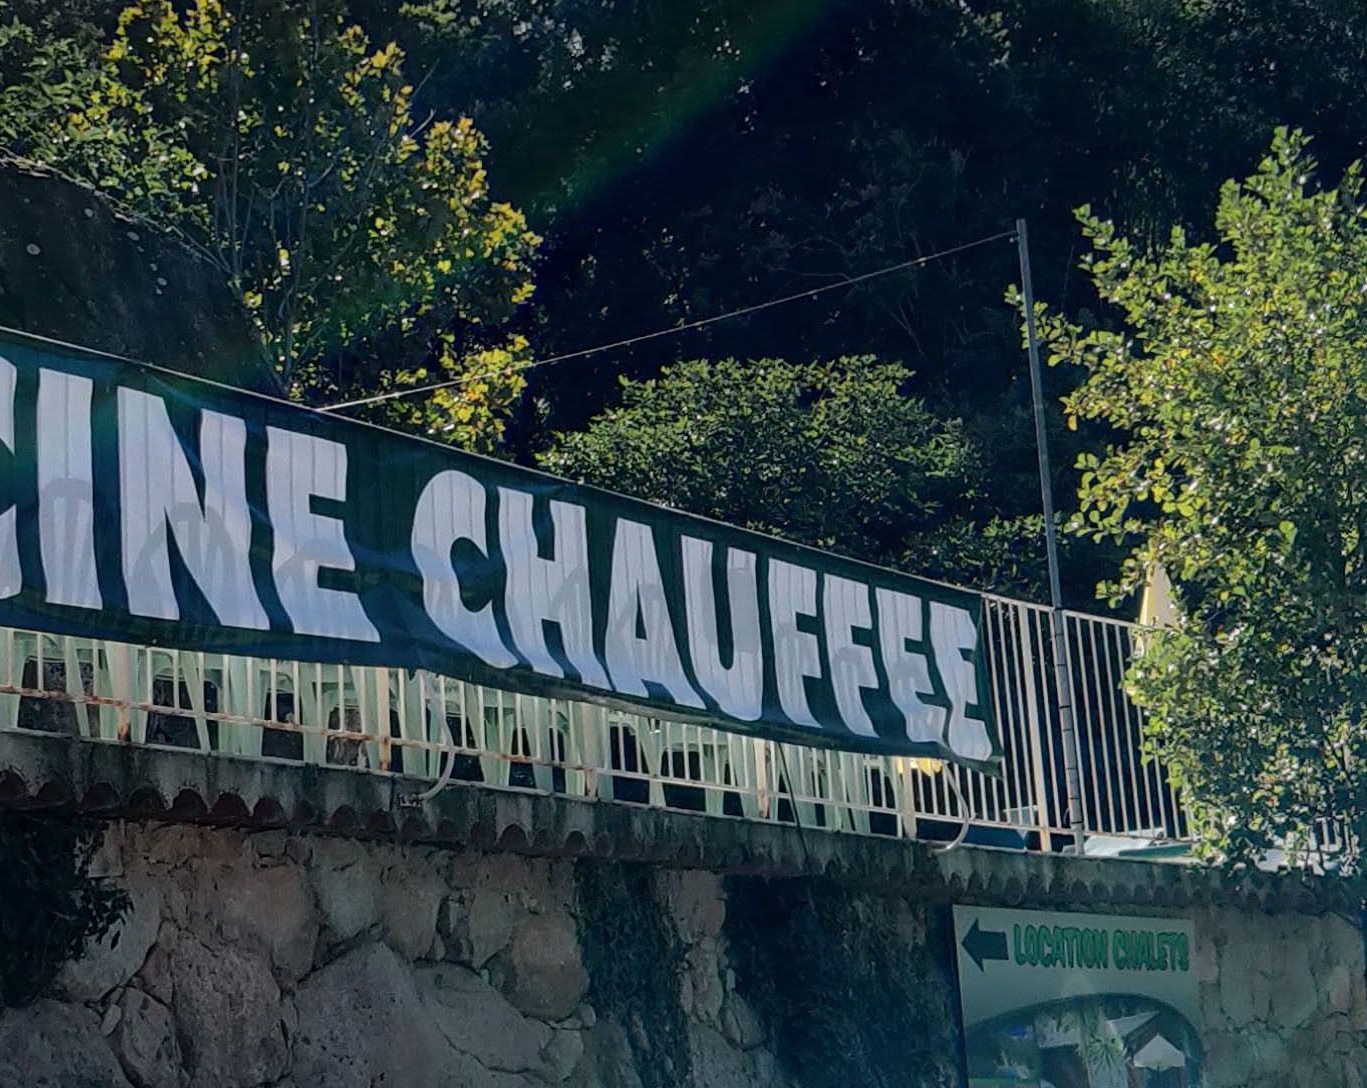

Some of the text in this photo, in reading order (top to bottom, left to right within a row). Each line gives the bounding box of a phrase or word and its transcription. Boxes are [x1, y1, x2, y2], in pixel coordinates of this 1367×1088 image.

[410, 469, 993, 763] CHAUFFEE
[1013, 923, 1190, 972] LOCATION CHALETS
